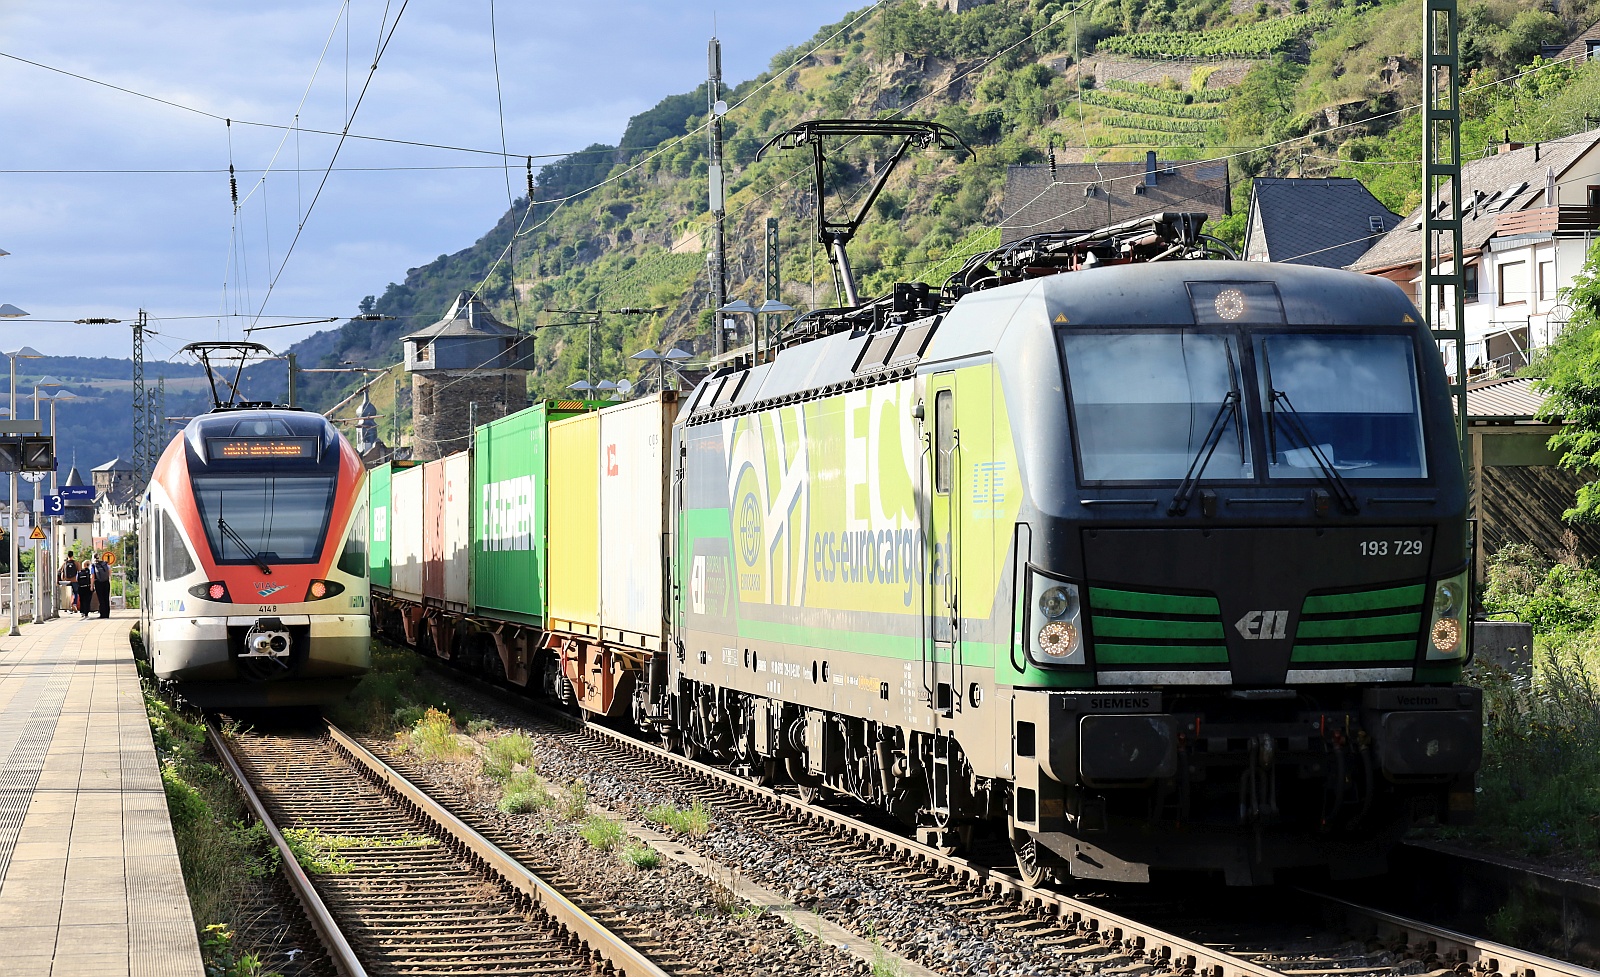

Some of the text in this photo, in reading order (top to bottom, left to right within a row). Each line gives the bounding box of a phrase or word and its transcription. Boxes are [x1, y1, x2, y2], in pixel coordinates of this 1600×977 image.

[973, 462, 1006, 503] LTE
[51, 495, 62, 512] 3
[1359, 540, 1423, 556] 193 729
[1090, 698, 1150, 709] SIEMENS
[1396, 695, 1438, 705] Vectron
